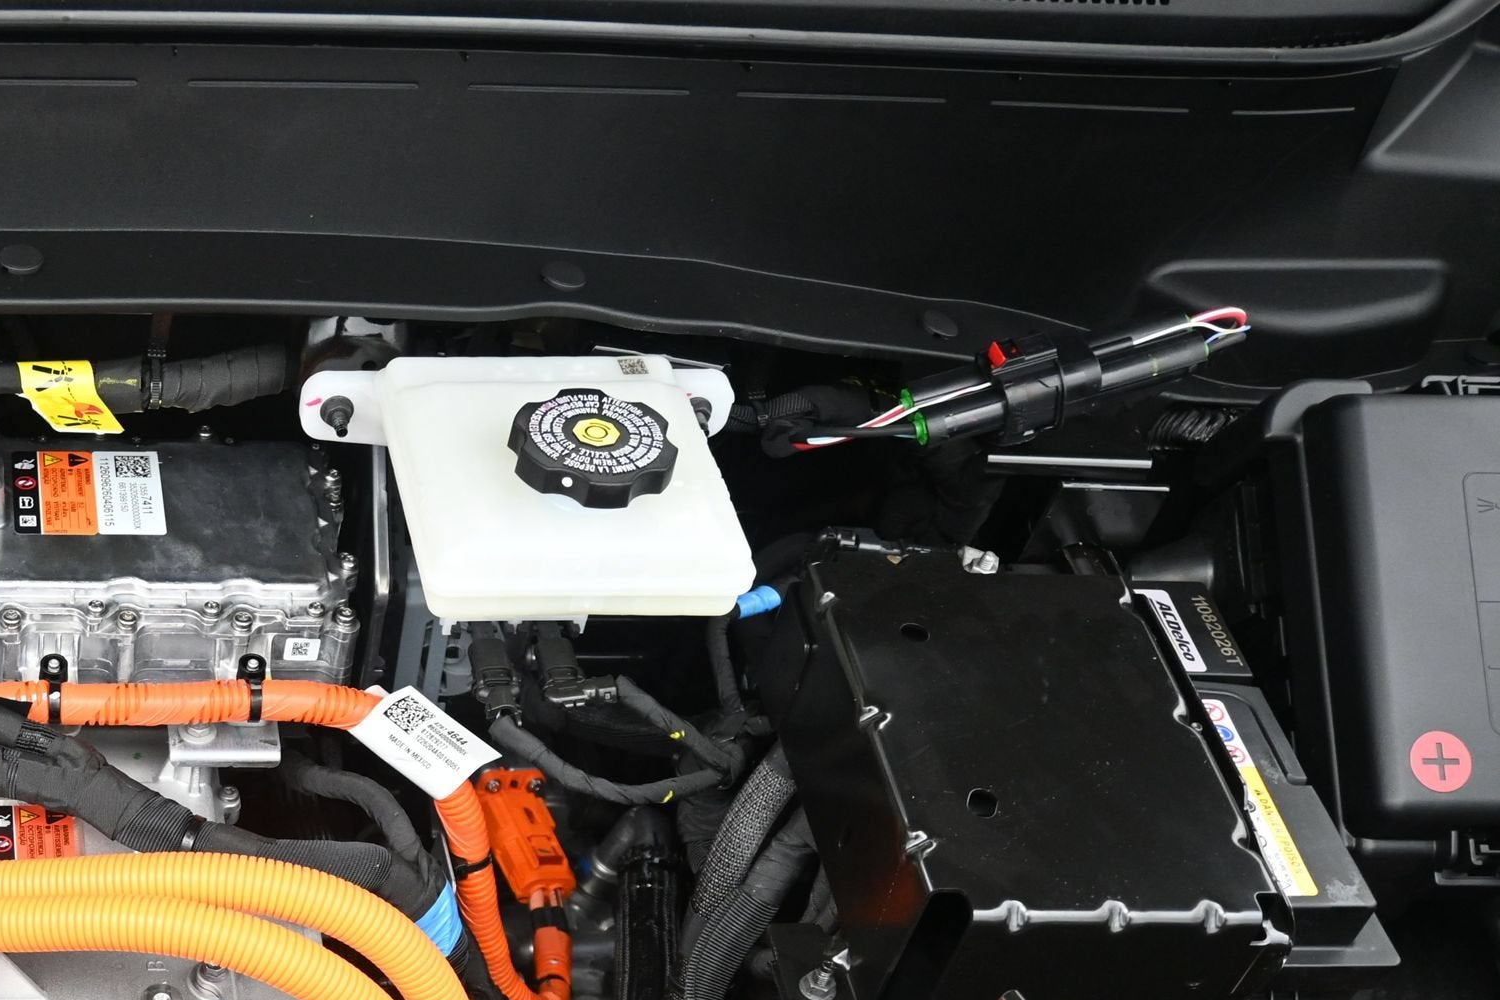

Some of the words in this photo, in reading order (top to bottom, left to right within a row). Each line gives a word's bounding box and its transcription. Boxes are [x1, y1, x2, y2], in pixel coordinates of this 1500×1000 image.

[601, 396, 645, 417] ATTENTION:
[568, 452, 590, 463] DOT4
[573, 447, 611, 458] SCELLE.
[559, 457, 595, 472] DEPOSE.
[610, 462, 638, 473] AVANT
[1156, 600, 1195, 662] ACDelco
[1190, 595, 1244, 667] 11082026T
[387, 733, 404, 748] MADE
[403, 745, 411, 754] IN
[410, 751, 432, 770] MEXICO
[53, 824, 61, 857] AVERTISSEMEN
